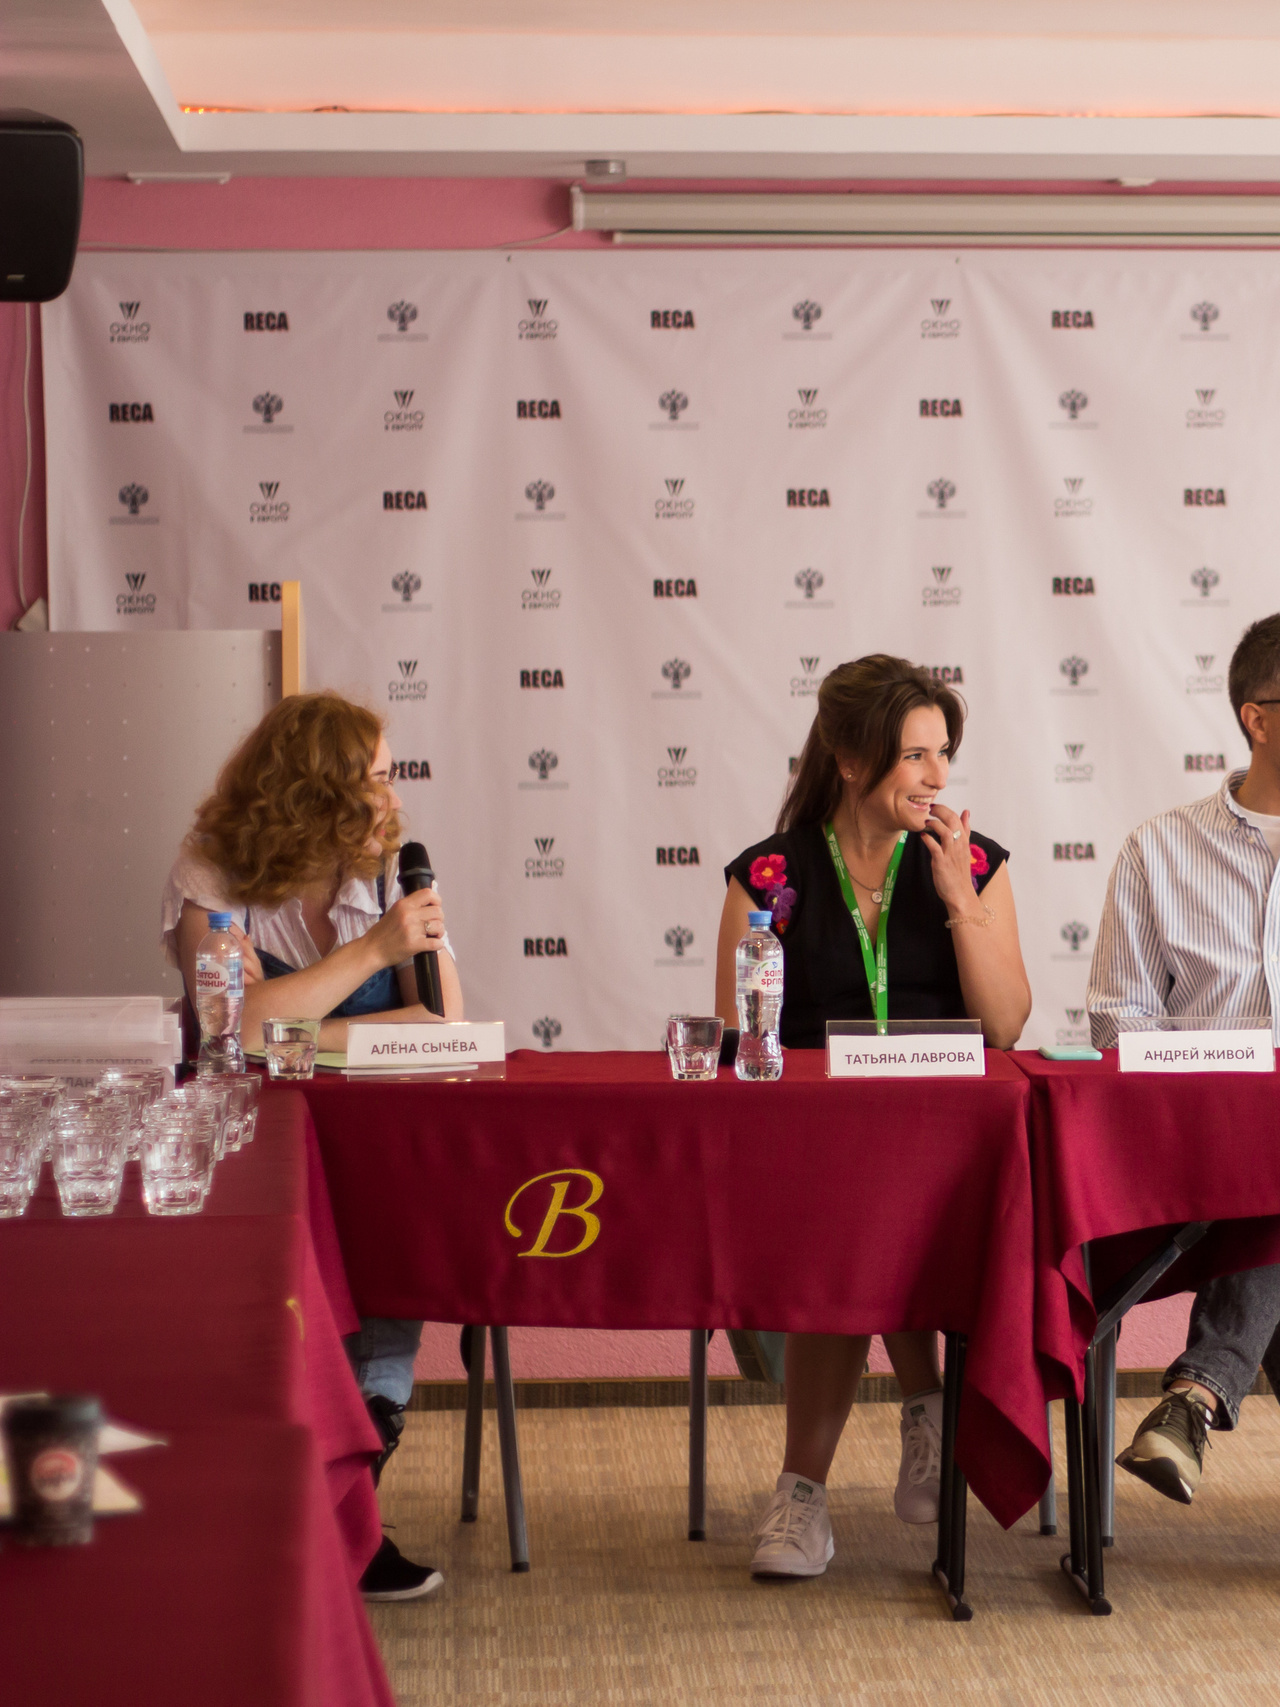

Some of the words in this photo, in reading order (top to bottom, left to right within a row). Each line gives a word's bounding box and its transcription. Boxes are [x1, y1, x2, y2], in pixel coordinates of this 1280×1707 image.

[243, 311, 289, 332] RECA
[650, 309, 695, 330] RECA
[1051, 310, 1095, 329] RECA
[108, 402, 154, 424] RECA
[517, 399, 562, 419] RECA
[919, 398, 963, 418] RECA
[383, 490, 427, 511] RECA
[786, 488, 830, 508] RECA
[1183, 488, 1227, 507] RECA
[248, 582, 282, 603] REC
[653, 578, 697, 598] RECA
[1052, 576, 1095, 596] RECA
[520, 669, 564, 689] RECA
[656, 846, 700, 866] RECA
[1053, 842, 1096, 861] RECA
[523, 937, 568, 957] RECA
[371, 1041, 417, 1054] АЛЁНА
[422, 1039, 477, 1053] СЫЧЁВА
[1144, 1048, 1198, 1062] АНДРЕЙ
[1204, 1047, 1254, 1059] ЖИВОЙ
[845, 1054, 906, 1064] ТАТЬЯНА
[911, 1052, 975, 1063] ЛАВРОВА
